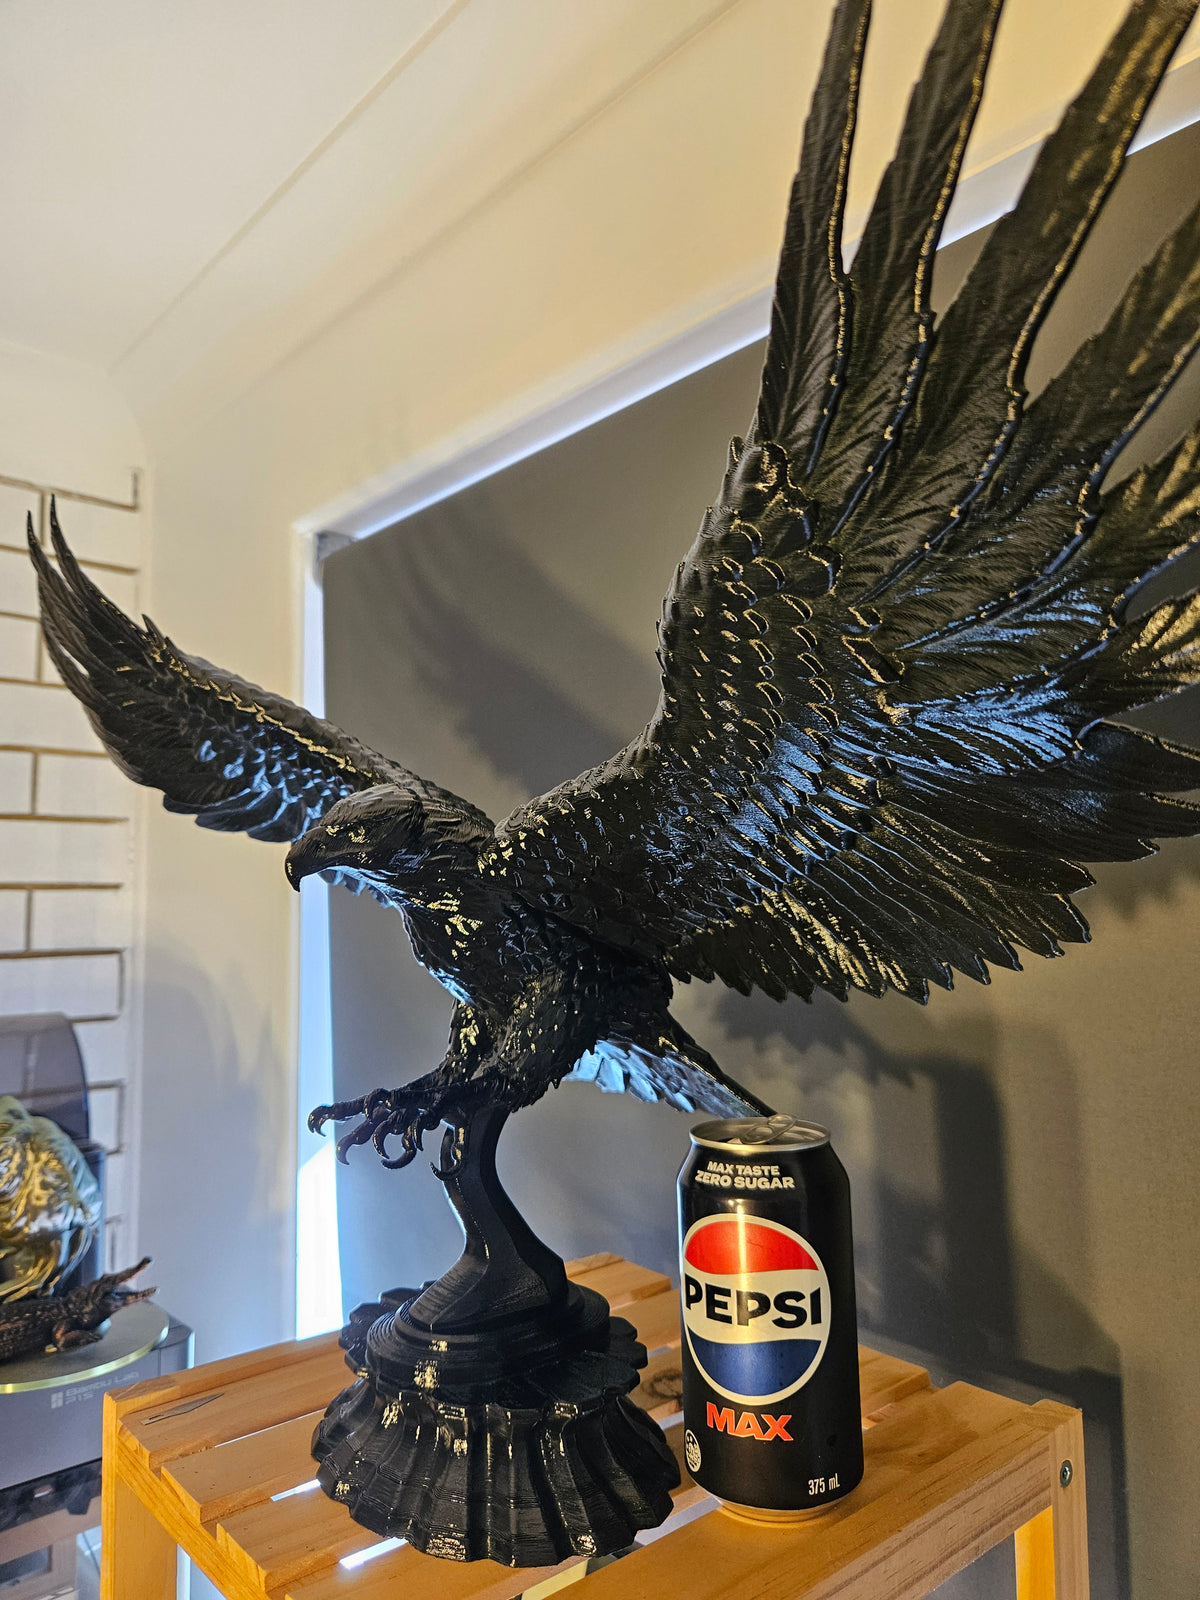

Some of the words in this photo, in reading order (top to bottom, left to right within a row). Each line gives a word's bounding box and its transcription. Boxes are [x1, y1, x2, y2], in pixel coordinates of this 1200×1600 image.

[695, 1170, 732, 1187] ZERO
[734, 1176, 795, 1189] SUGAR
[707, 1161, 734, 1175] MAX
[736, 1164, 780, 1176] TASTE
[685, 1273, 822, 1329] PEPSI
[706, 1401, 794, 1441] MAX
[808, 1477, 826, 1496] 375
[828, 1472, 841, 1491] mL
